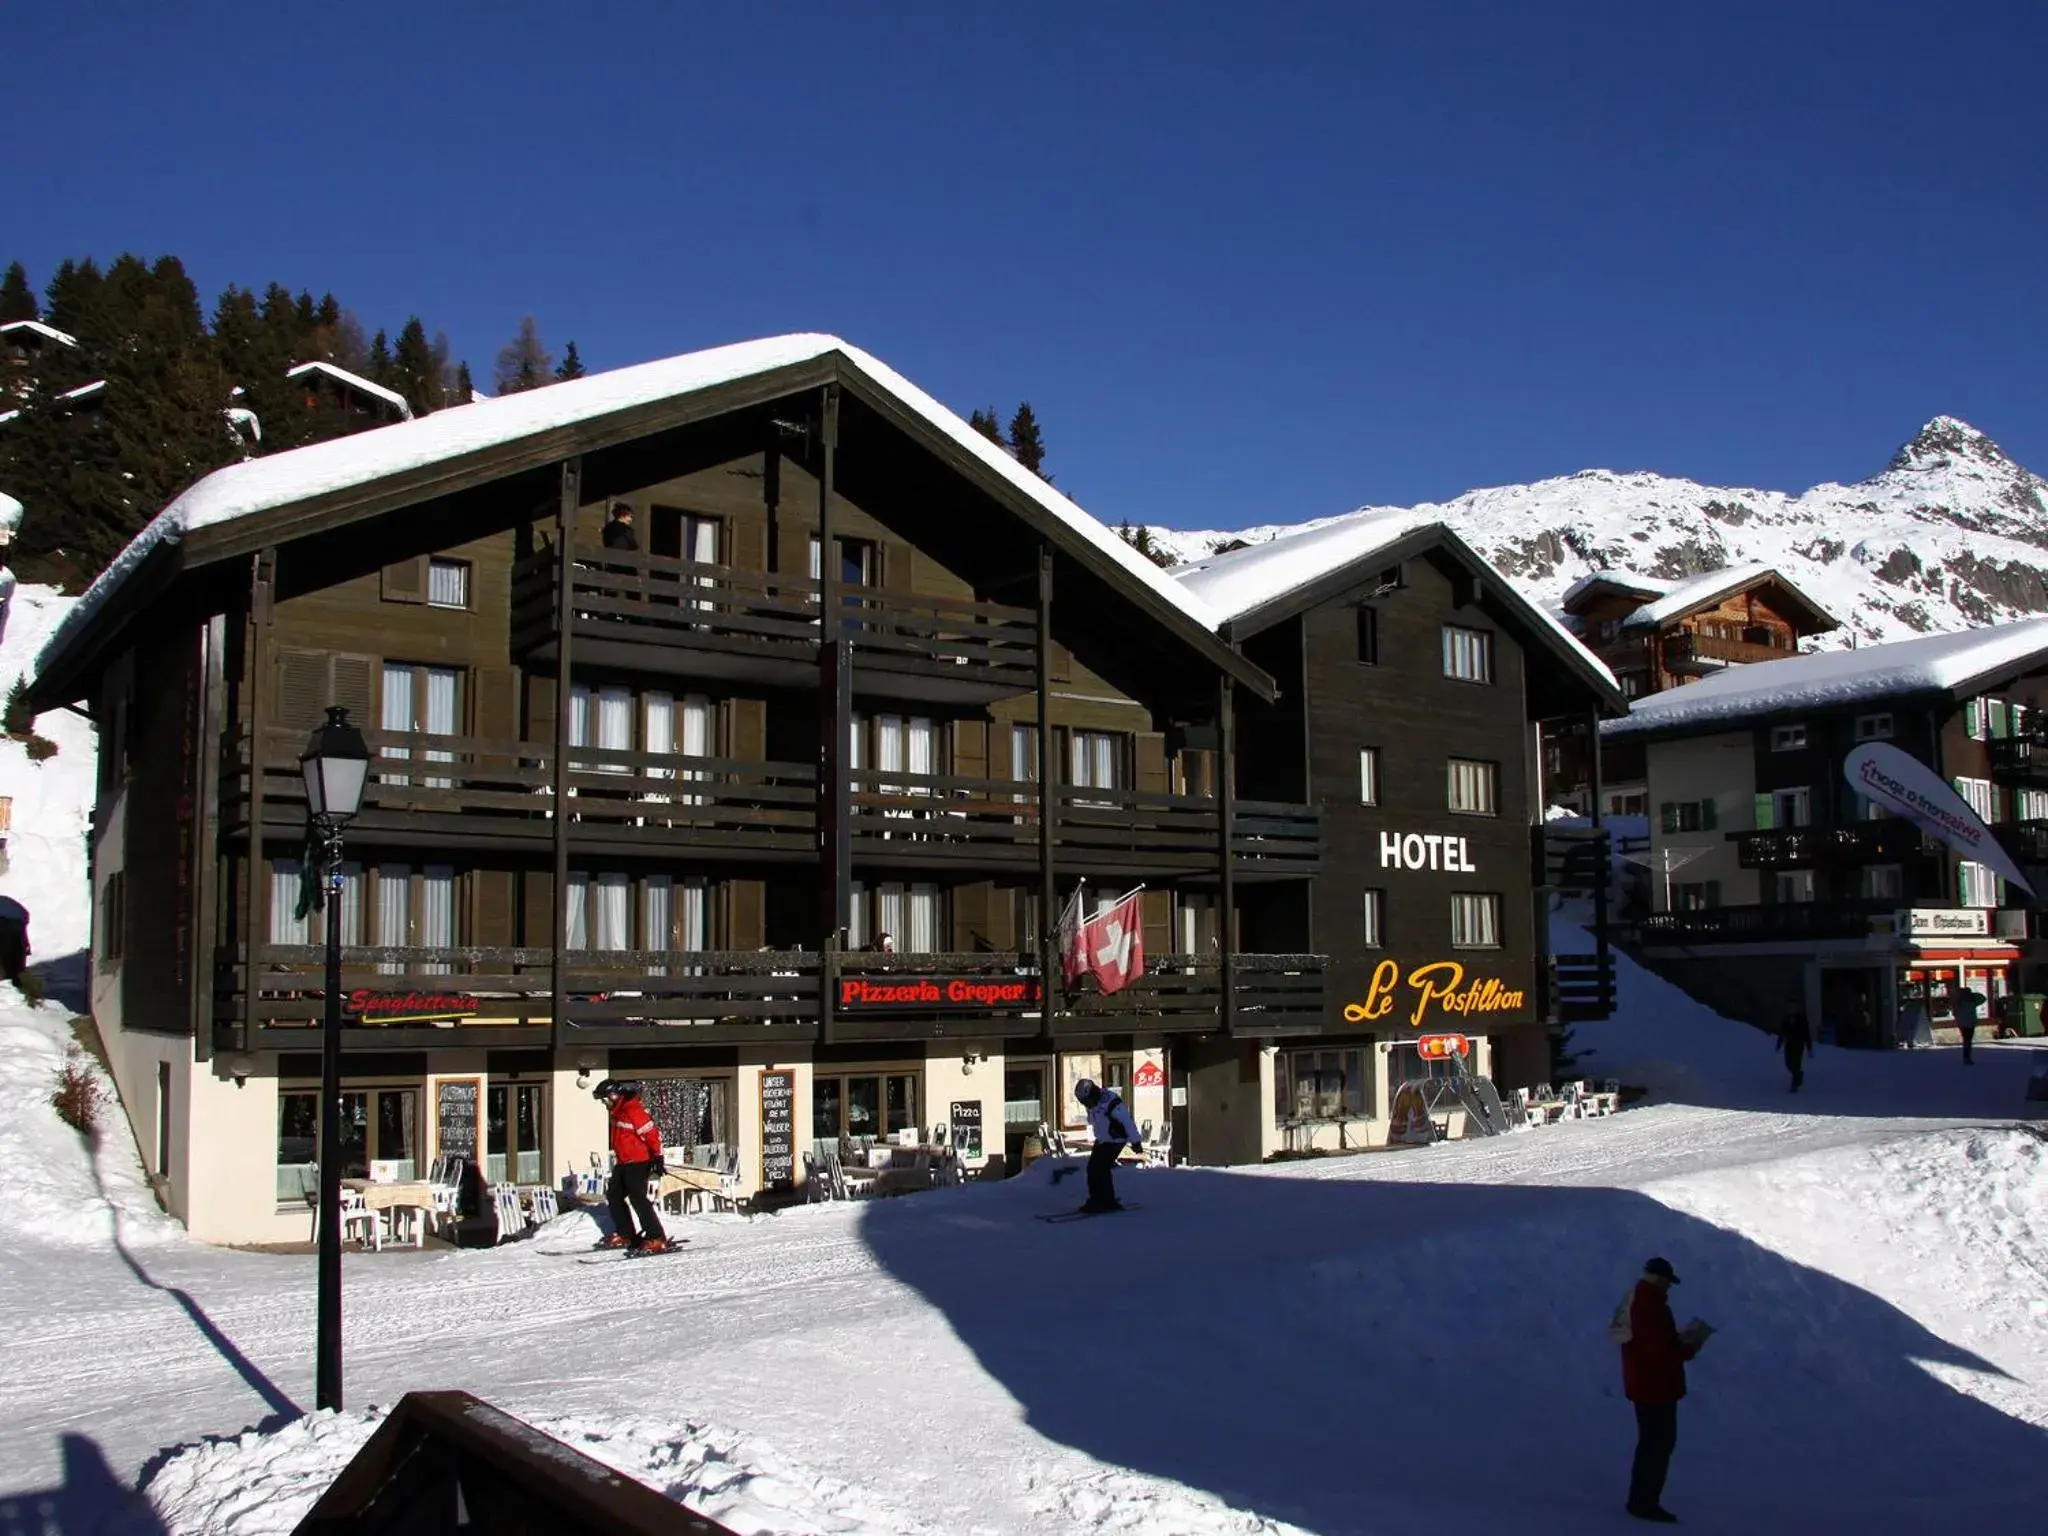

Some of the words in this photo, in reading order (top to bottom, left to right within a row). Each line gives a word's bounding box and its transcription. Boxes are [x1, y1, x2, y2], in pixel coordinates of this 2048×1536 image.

[1380, 831, 1475, 873] HOTEL
[841, 977, 941, 1004] Pizzeria
[1344, 959, 1400, 1022] Le
[1407, 960, 1525, 1027] Postillion
